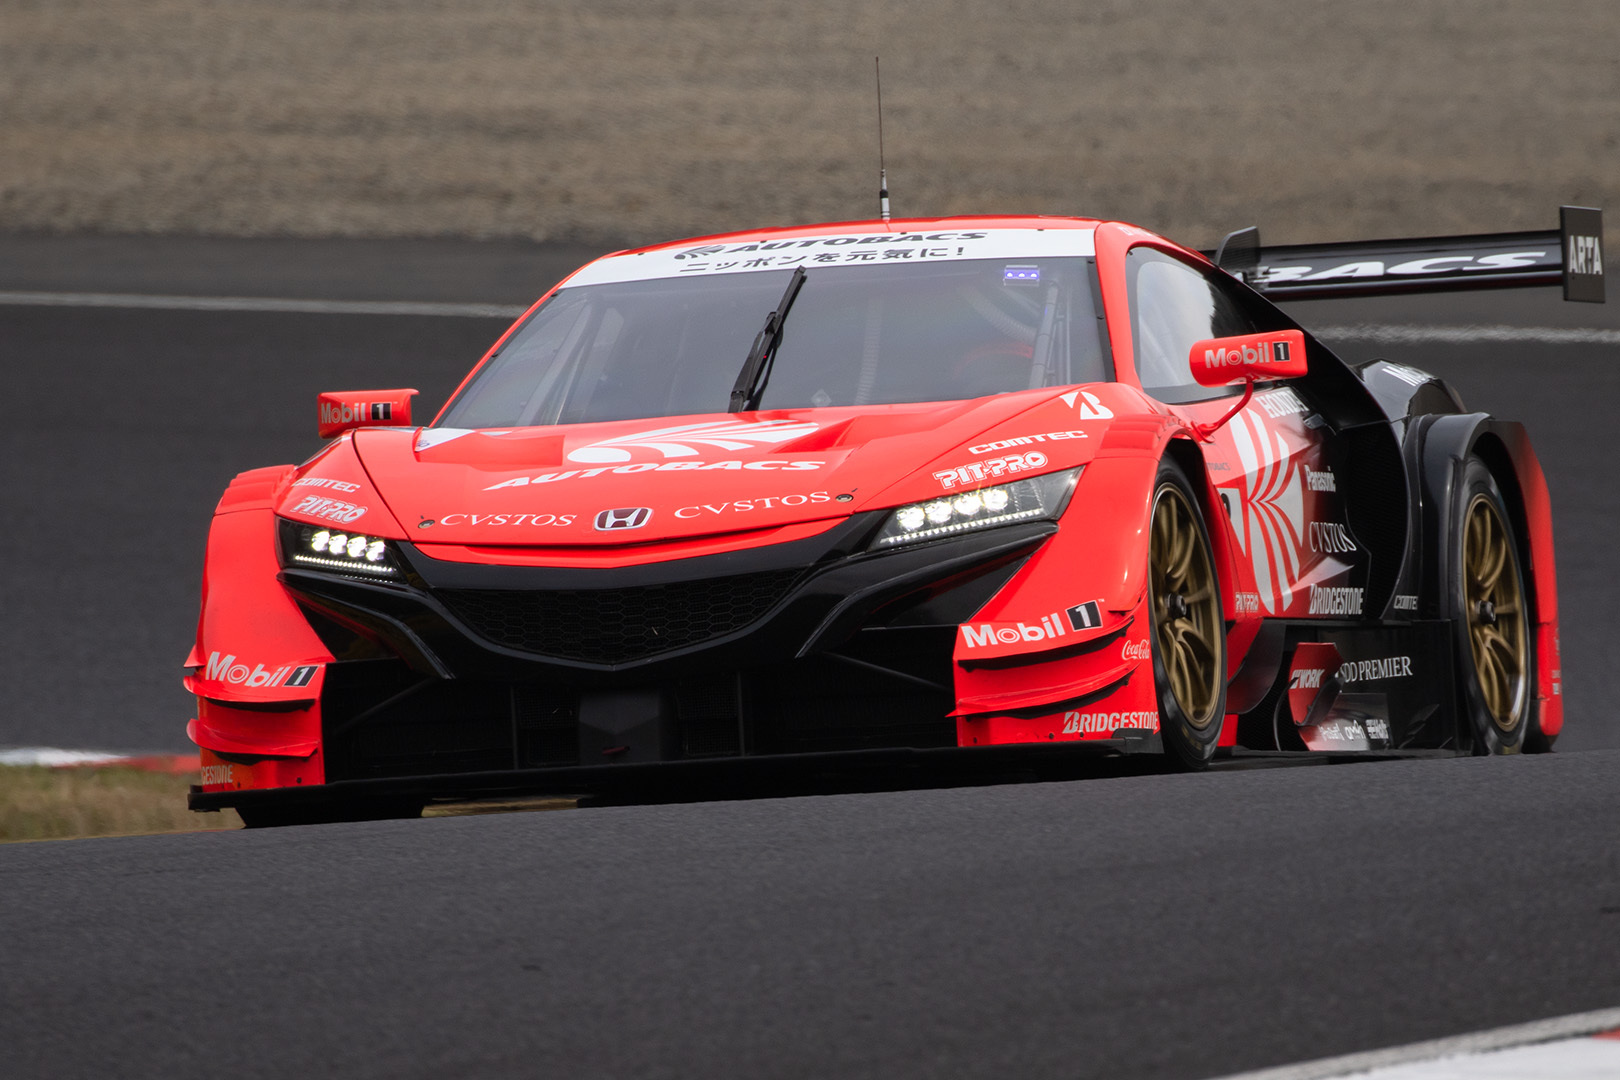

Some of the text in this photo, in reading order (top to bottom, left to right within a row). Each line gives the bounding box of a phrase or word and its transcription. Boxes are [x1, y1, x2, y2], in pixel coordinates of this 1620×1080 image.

[724, 231, 988, 254] AUTOBACS
[1568, 235, 1602, 275] ARTA
[1205, 342, 1270, 368] Mobil
[320, 402, 366, 424] Mobil
[1255, 390, 1310, 418] HONDA
[968, 430, 1088, 455] COMTEC
[291, 478, 360, 493] COMTEC
[482, 460, 826, 491] AUTOBACS
[1304, 464, 1336, 492] Panasonic
[674, 491, 831, 519] CVSTOS
[440, 514, 577, 527] CVSTOS
[1309, 521, 1357, 553] CVSTOS
[1309, 583, 1364, 615] BRIDGESTONE
[961, 612, 1066, 648] Mobil
[205, 651, 291, 687] Mobil
[1358, 656, 1413, 681] PREMIER
[1062, 711, 1159, 734] BRIDGESTONE
